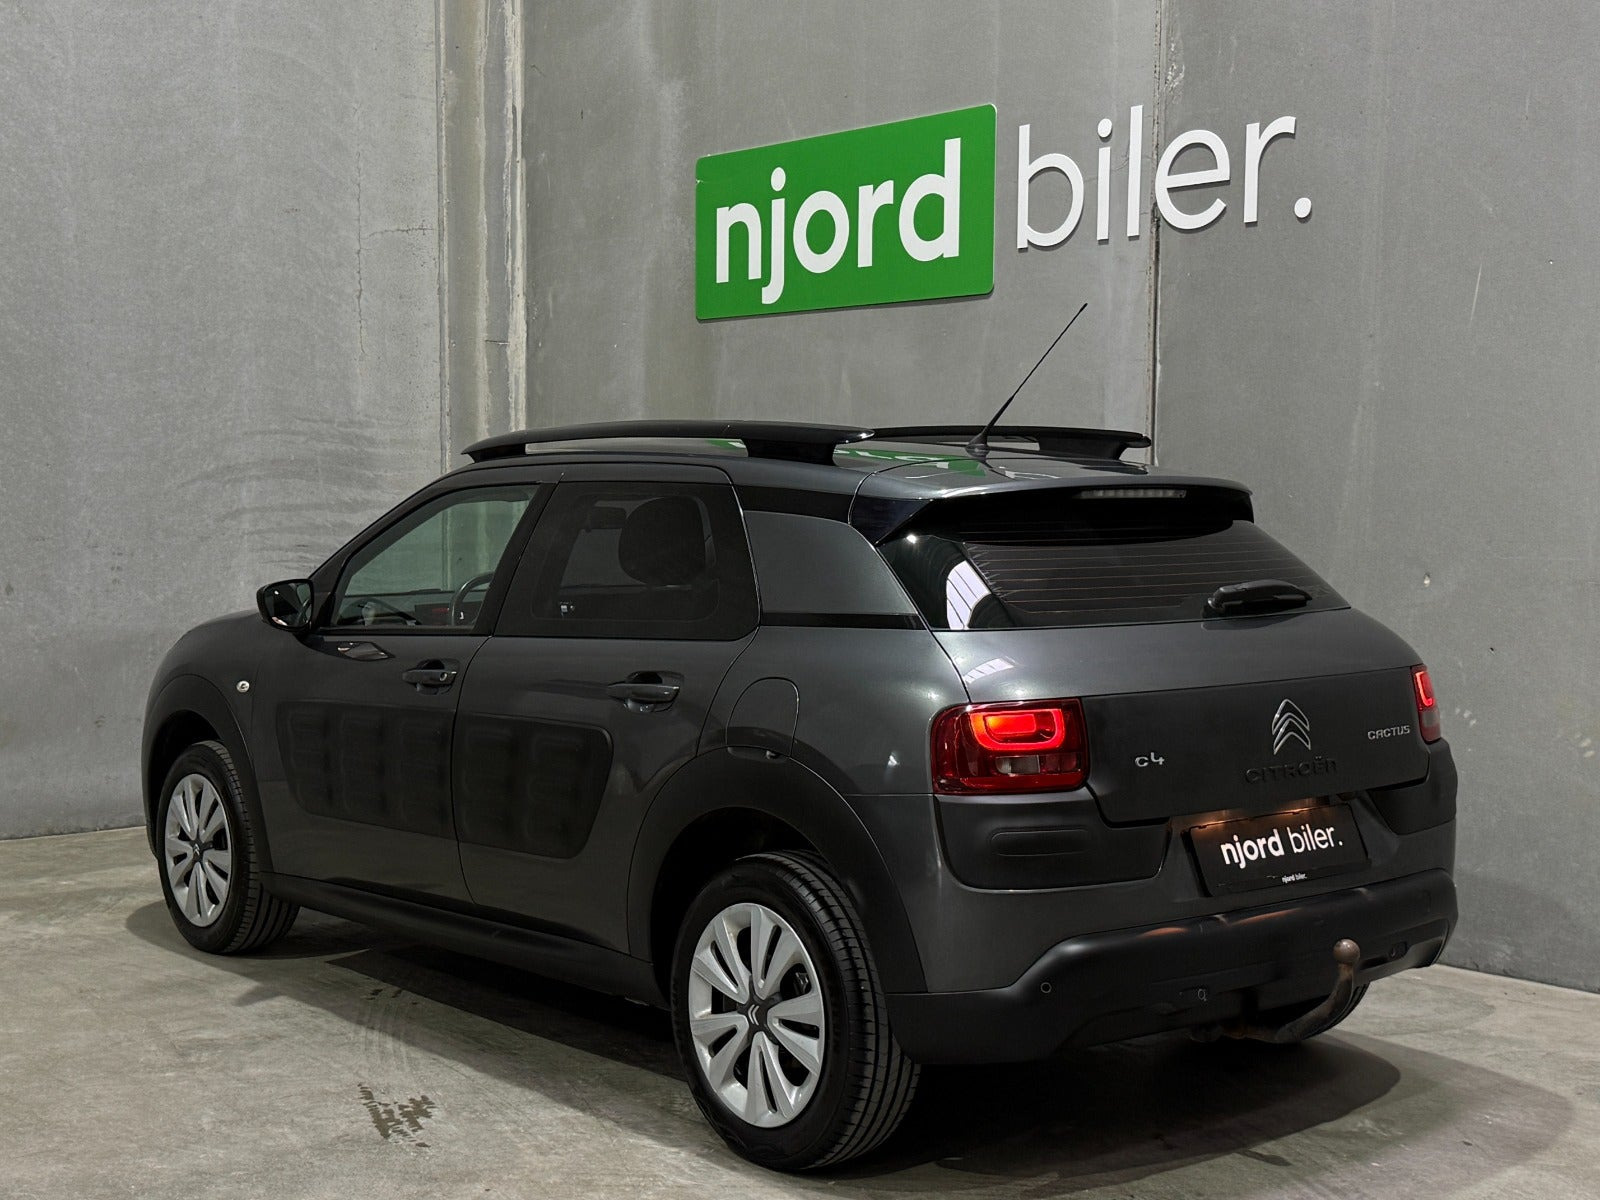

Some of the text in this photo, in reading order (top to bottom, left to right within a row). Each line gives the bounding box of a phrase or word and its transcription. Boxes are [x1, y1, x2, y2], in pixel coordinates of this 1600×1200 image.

[715, 104, 1312, 305] njord biler.
[1367, 724, 1411, 740] CACTUS
[1220, 823, 1344, 869] njord biler.
